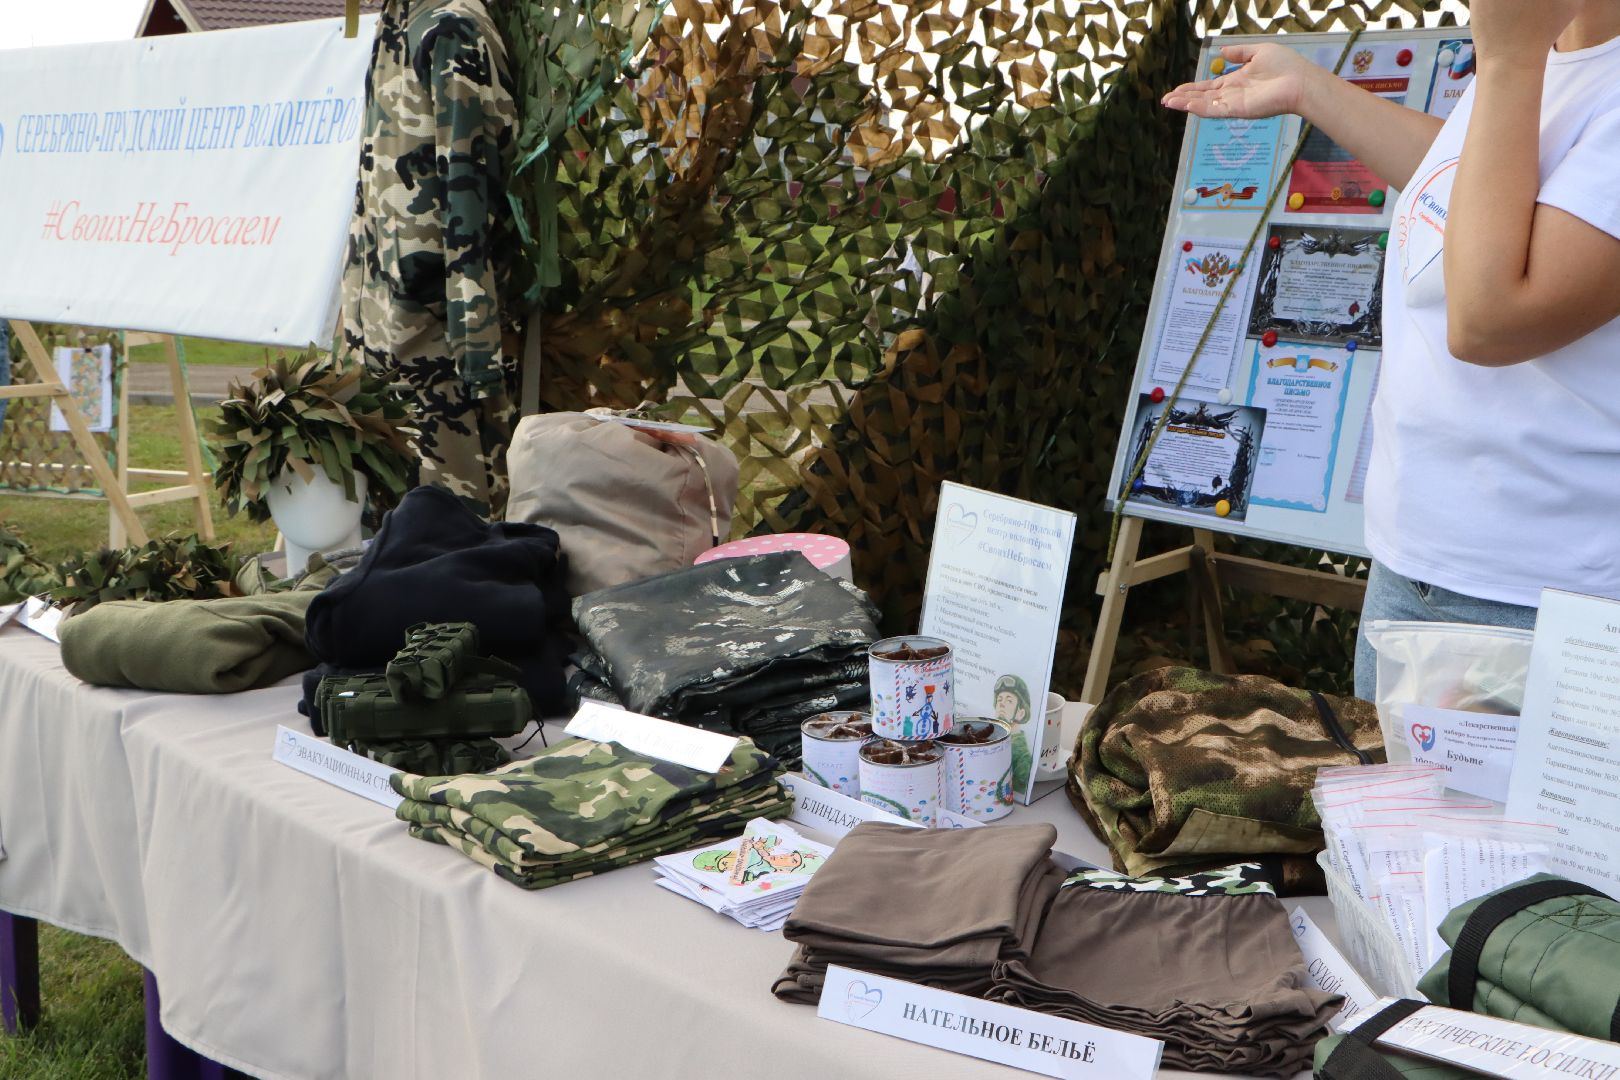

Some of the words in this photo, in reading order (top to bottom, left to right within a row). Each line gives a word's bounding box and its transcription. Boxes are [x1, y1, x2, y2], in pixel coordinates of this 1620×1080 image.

[15, 97, 187, 157] СЕРЕБРЯНО-ПРУДСКИЙ
[185, 104, 247, 154] ЦЕНТР
[41, 200, 282, 256] #СвоихНеБросаем
[297, 744, 371, 785] ЭВАКУАЦИОННАЯ
[373, 775, 402, 797] СТРО
[1447, 749, 1484, 766] Будьте
[800, 796, 862, 829] БЛИНДАЖ
[1308, 957, 1344, 994] СУХОЙ
[902, 1002, 1023, 1046] НАТЕЛЬНОЕ
[1028, 1032, 1097, 1064] БЕЛЬЁ
[1399, 1017, 1516, 1057] ТАКТИЧЕСКИЕ
